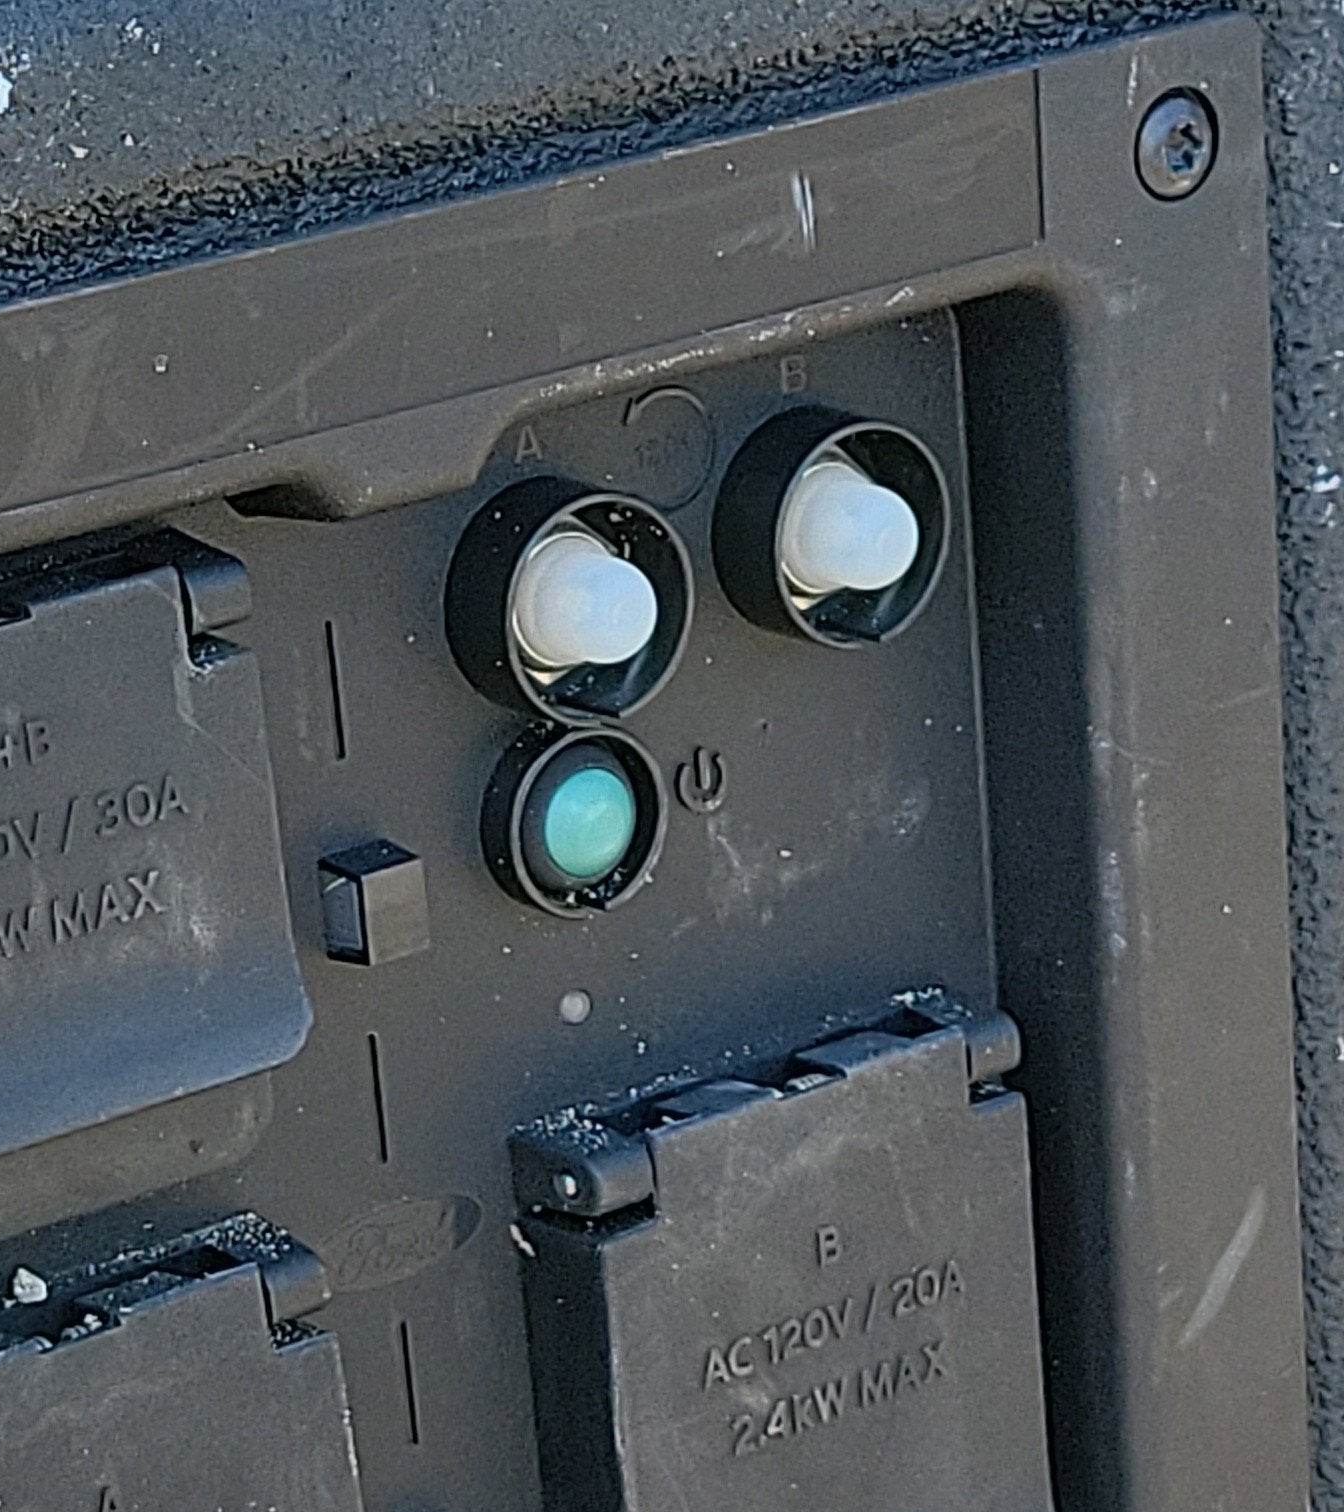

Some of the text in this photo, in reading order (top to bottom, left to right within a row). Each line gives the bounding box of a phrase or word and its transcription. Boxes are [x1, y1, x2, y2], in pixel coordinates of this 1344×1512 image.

[780, 356, 807, 394] B
[514, 425, 544, 463] A
[60, 795, 77, 856] /
[95, 775, 191, 837] 30A
[52, 869, 168, 946] MAX
[815, 1224, 843, 1269] B
[703, 1259, 967, 1391] AC 120V / 20A
[858, 1340, 950, 1410] MAX
